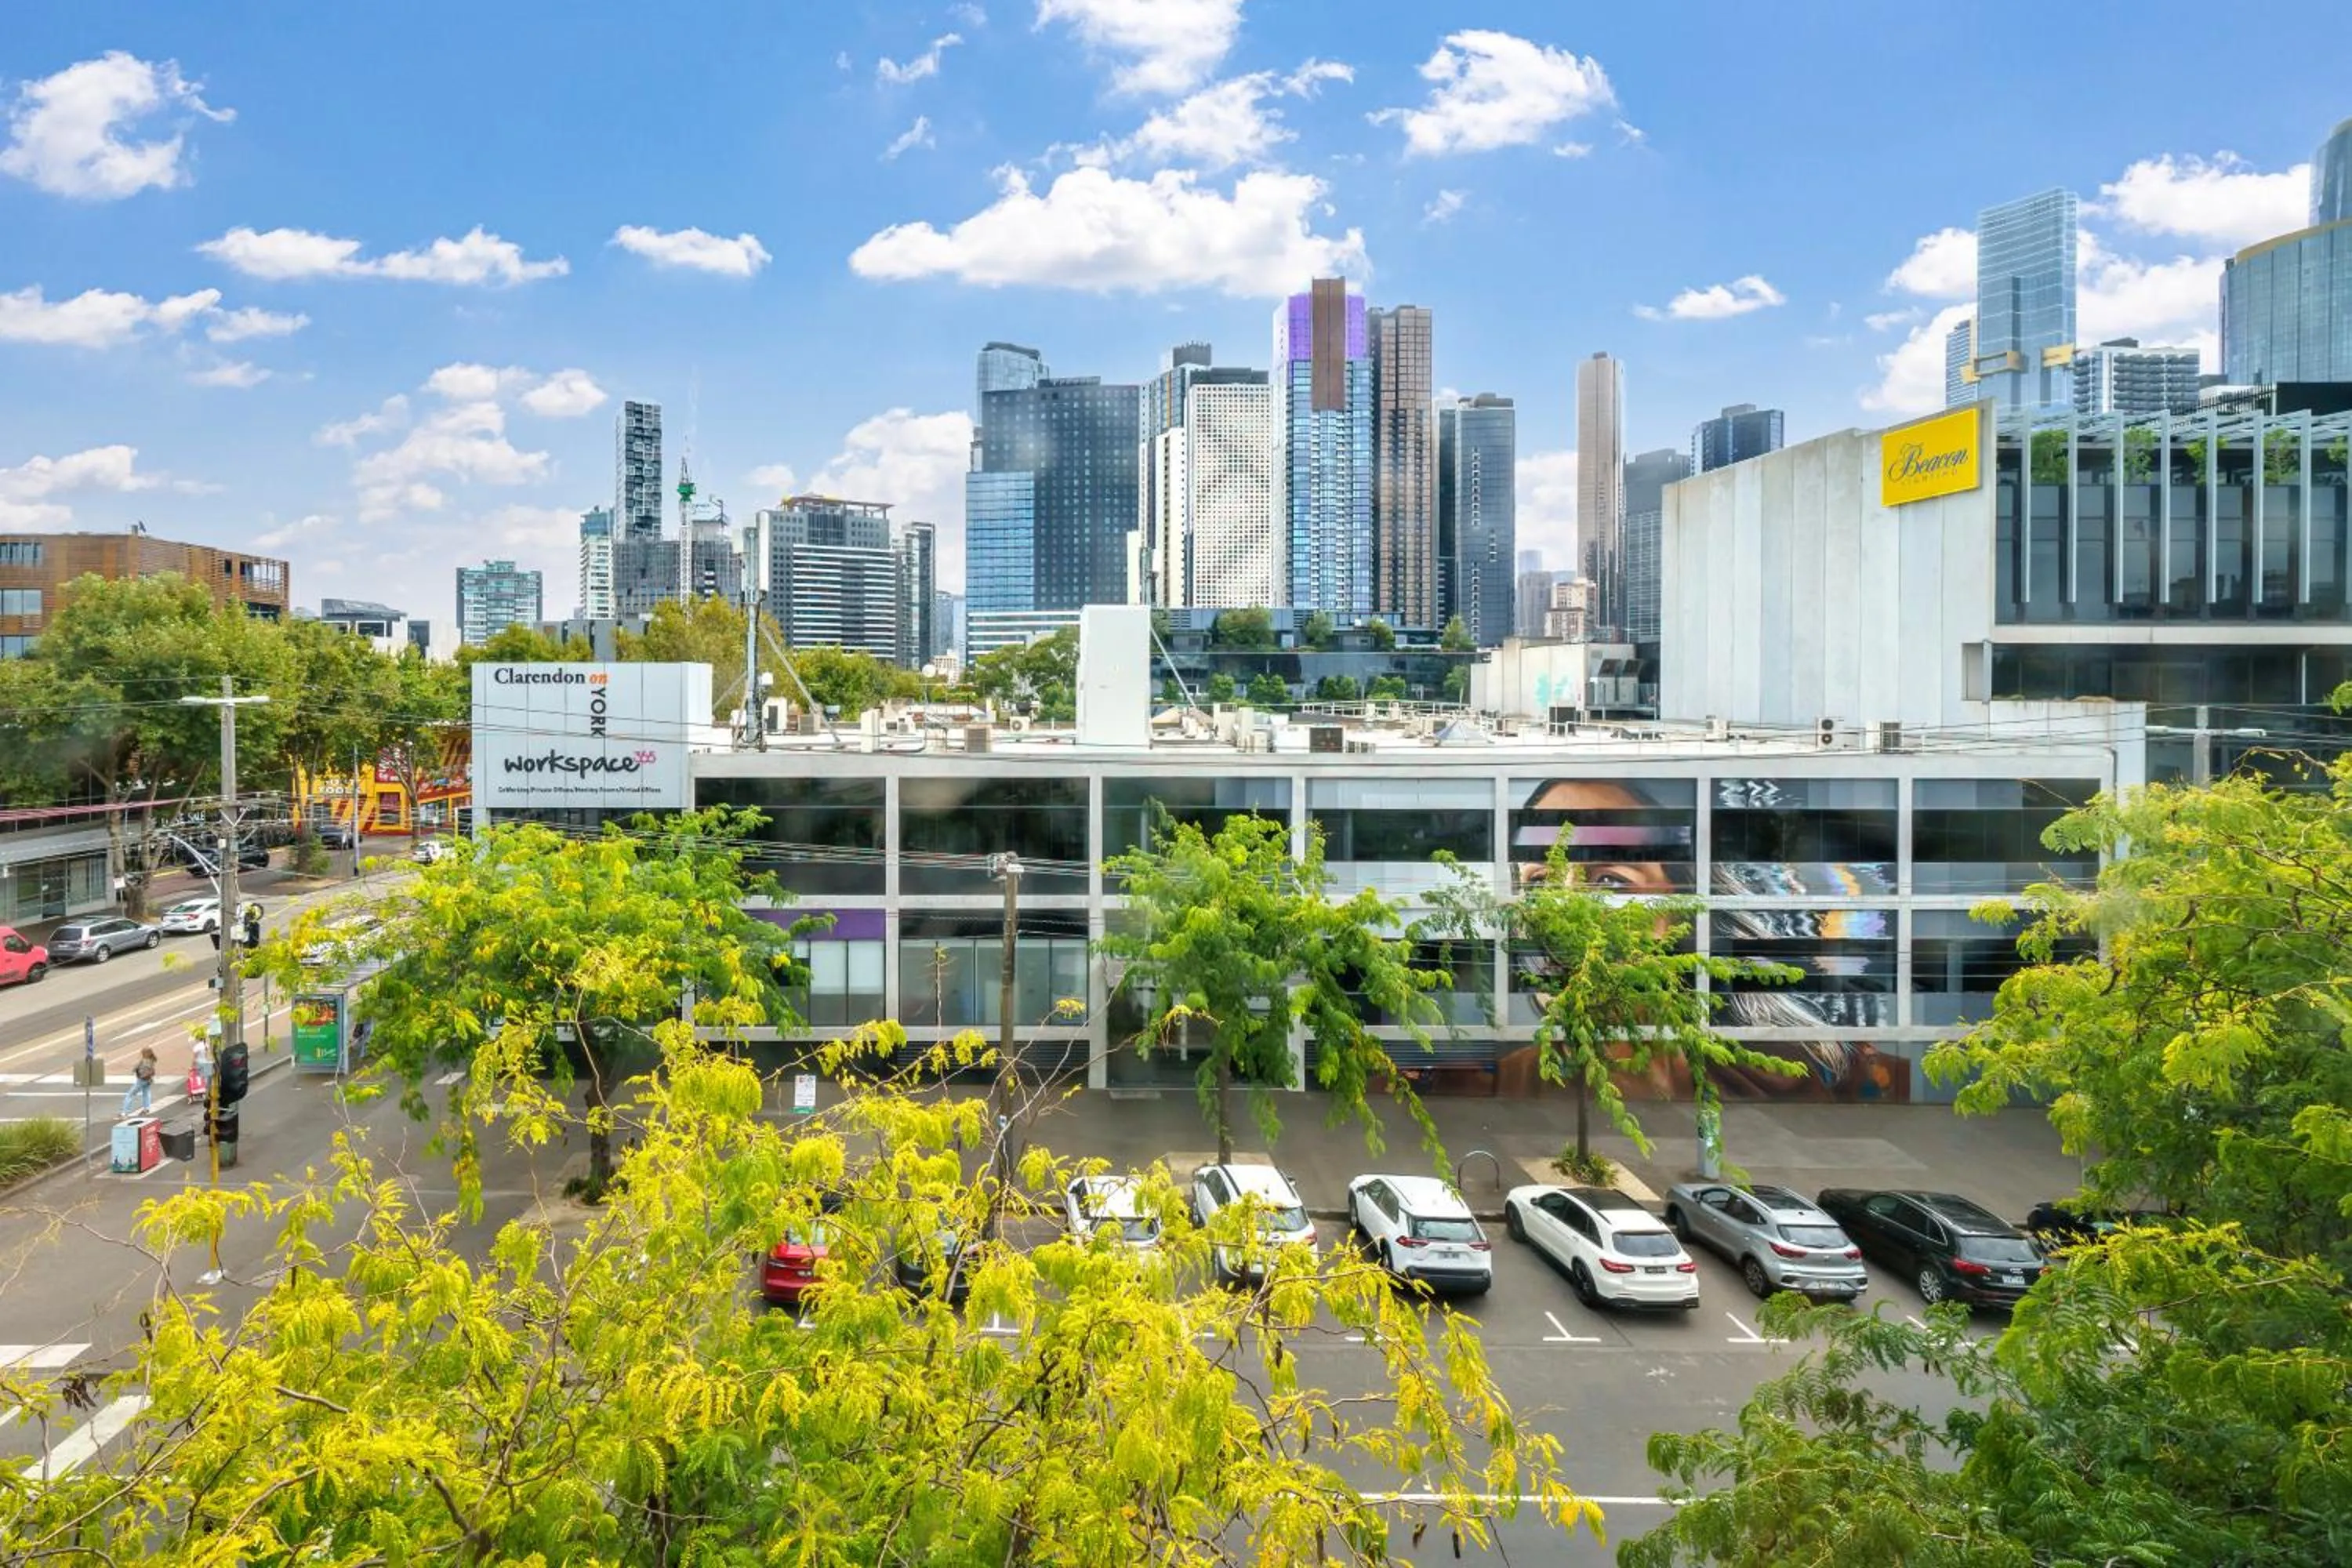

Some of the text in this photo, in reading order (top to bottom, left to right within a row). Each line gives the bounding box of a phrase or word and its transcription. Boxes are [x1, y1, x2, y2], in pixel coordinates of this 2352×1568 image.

[1888, 442, 1969, 483] Beacon
[494, 667, 608, 684] Clarendon on
[590, 687, 606, 738] YORK
[504, 749, 641, 779] workspace
